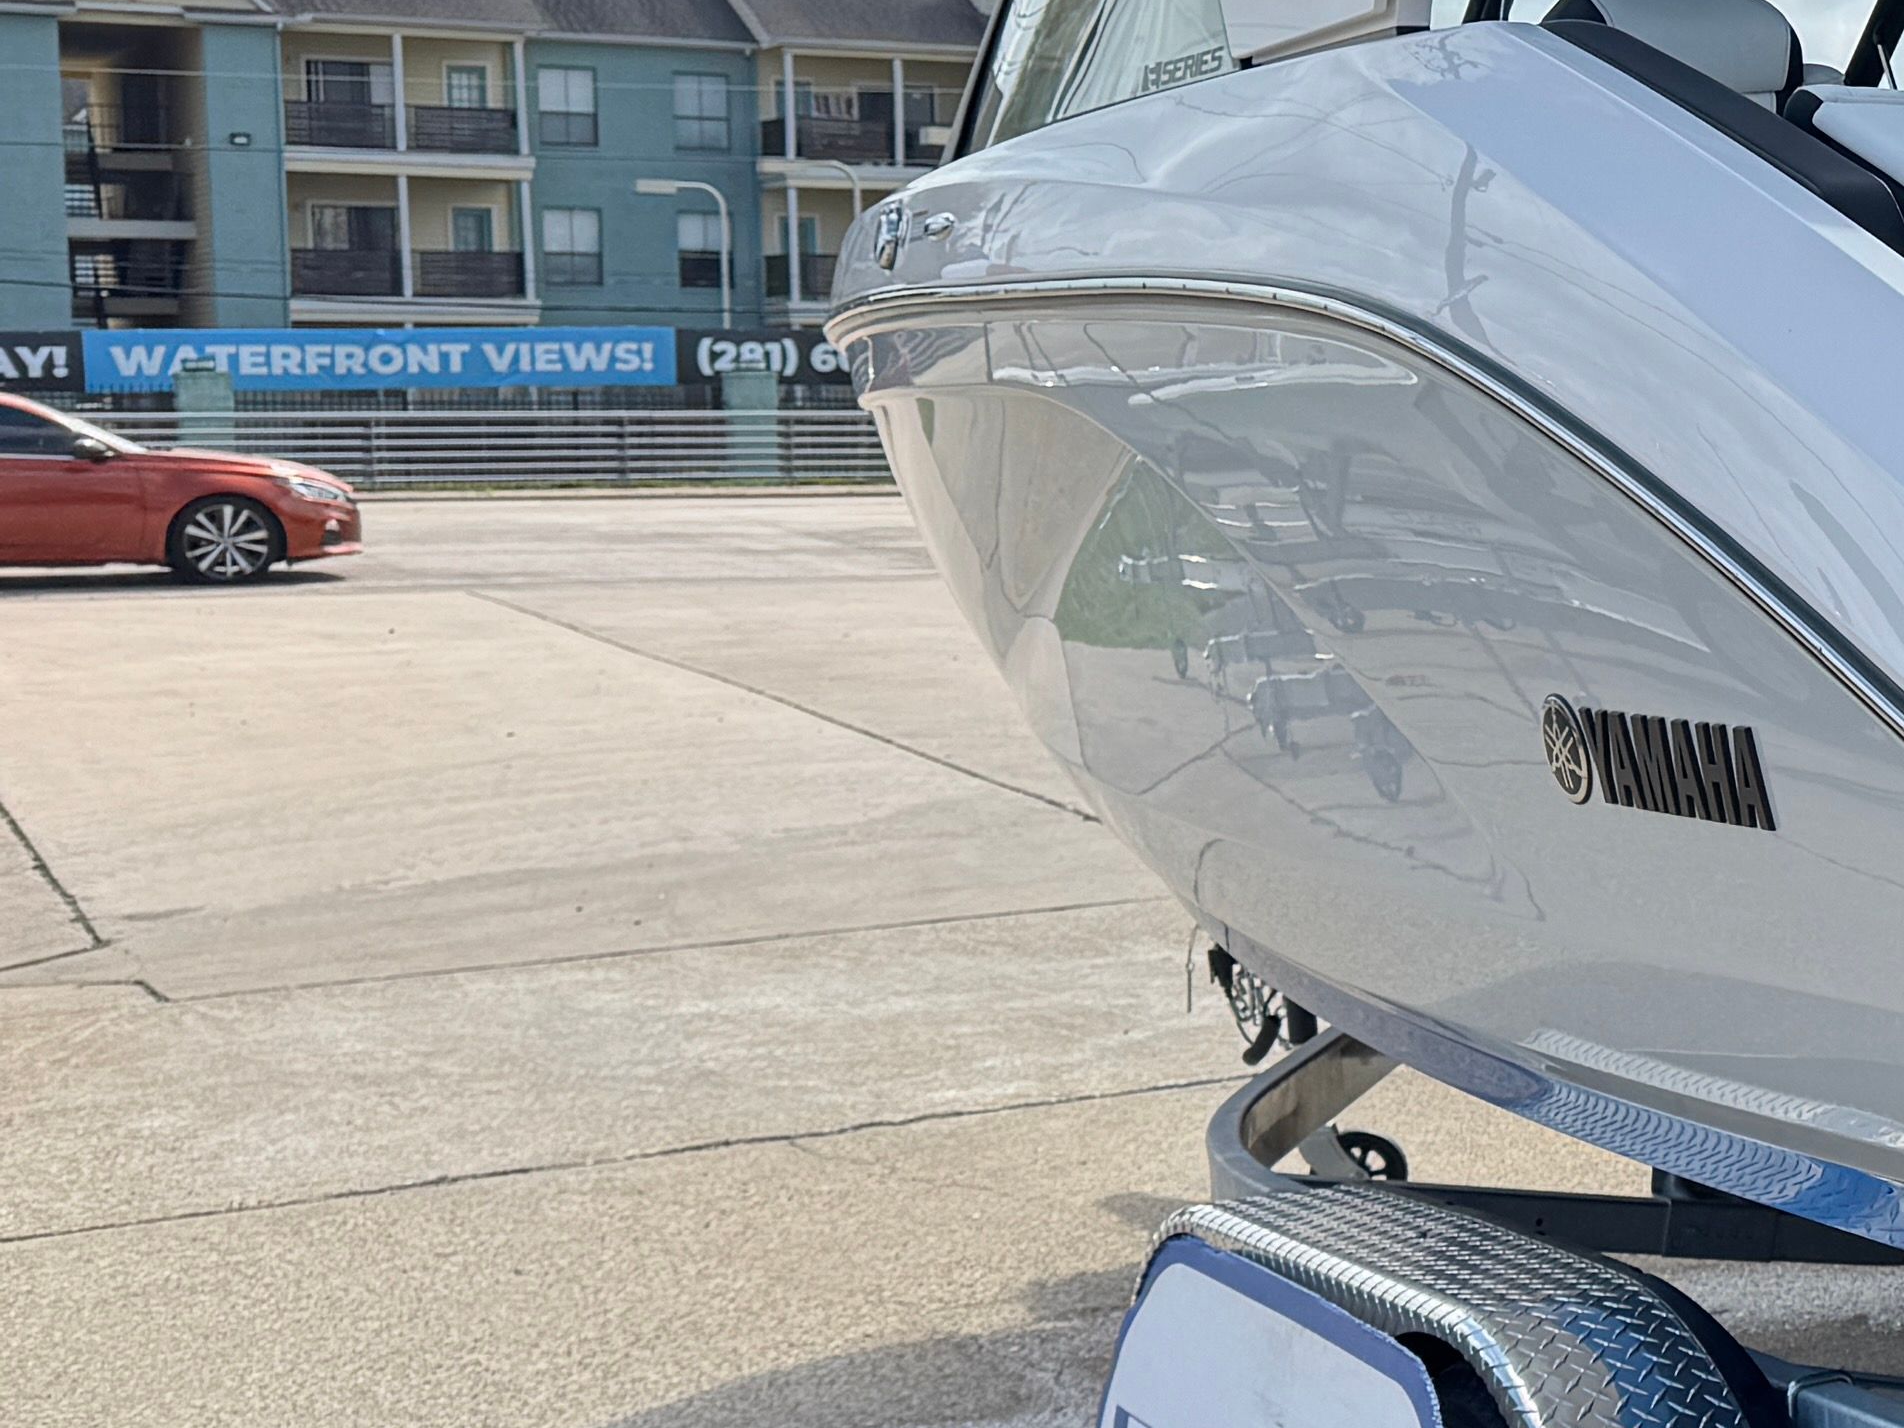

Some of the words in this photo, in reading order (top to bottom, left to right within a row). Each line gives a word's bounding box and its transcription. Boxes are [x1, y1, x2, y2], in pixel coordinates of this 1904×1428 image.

[1161, 45, 1225, 85] SERIES
[109, 343, 469, 377] WATERFRONT
[482, 341, 654, 372] VIEWS!
[1578, 706, 1777, 832] YAMAHA
